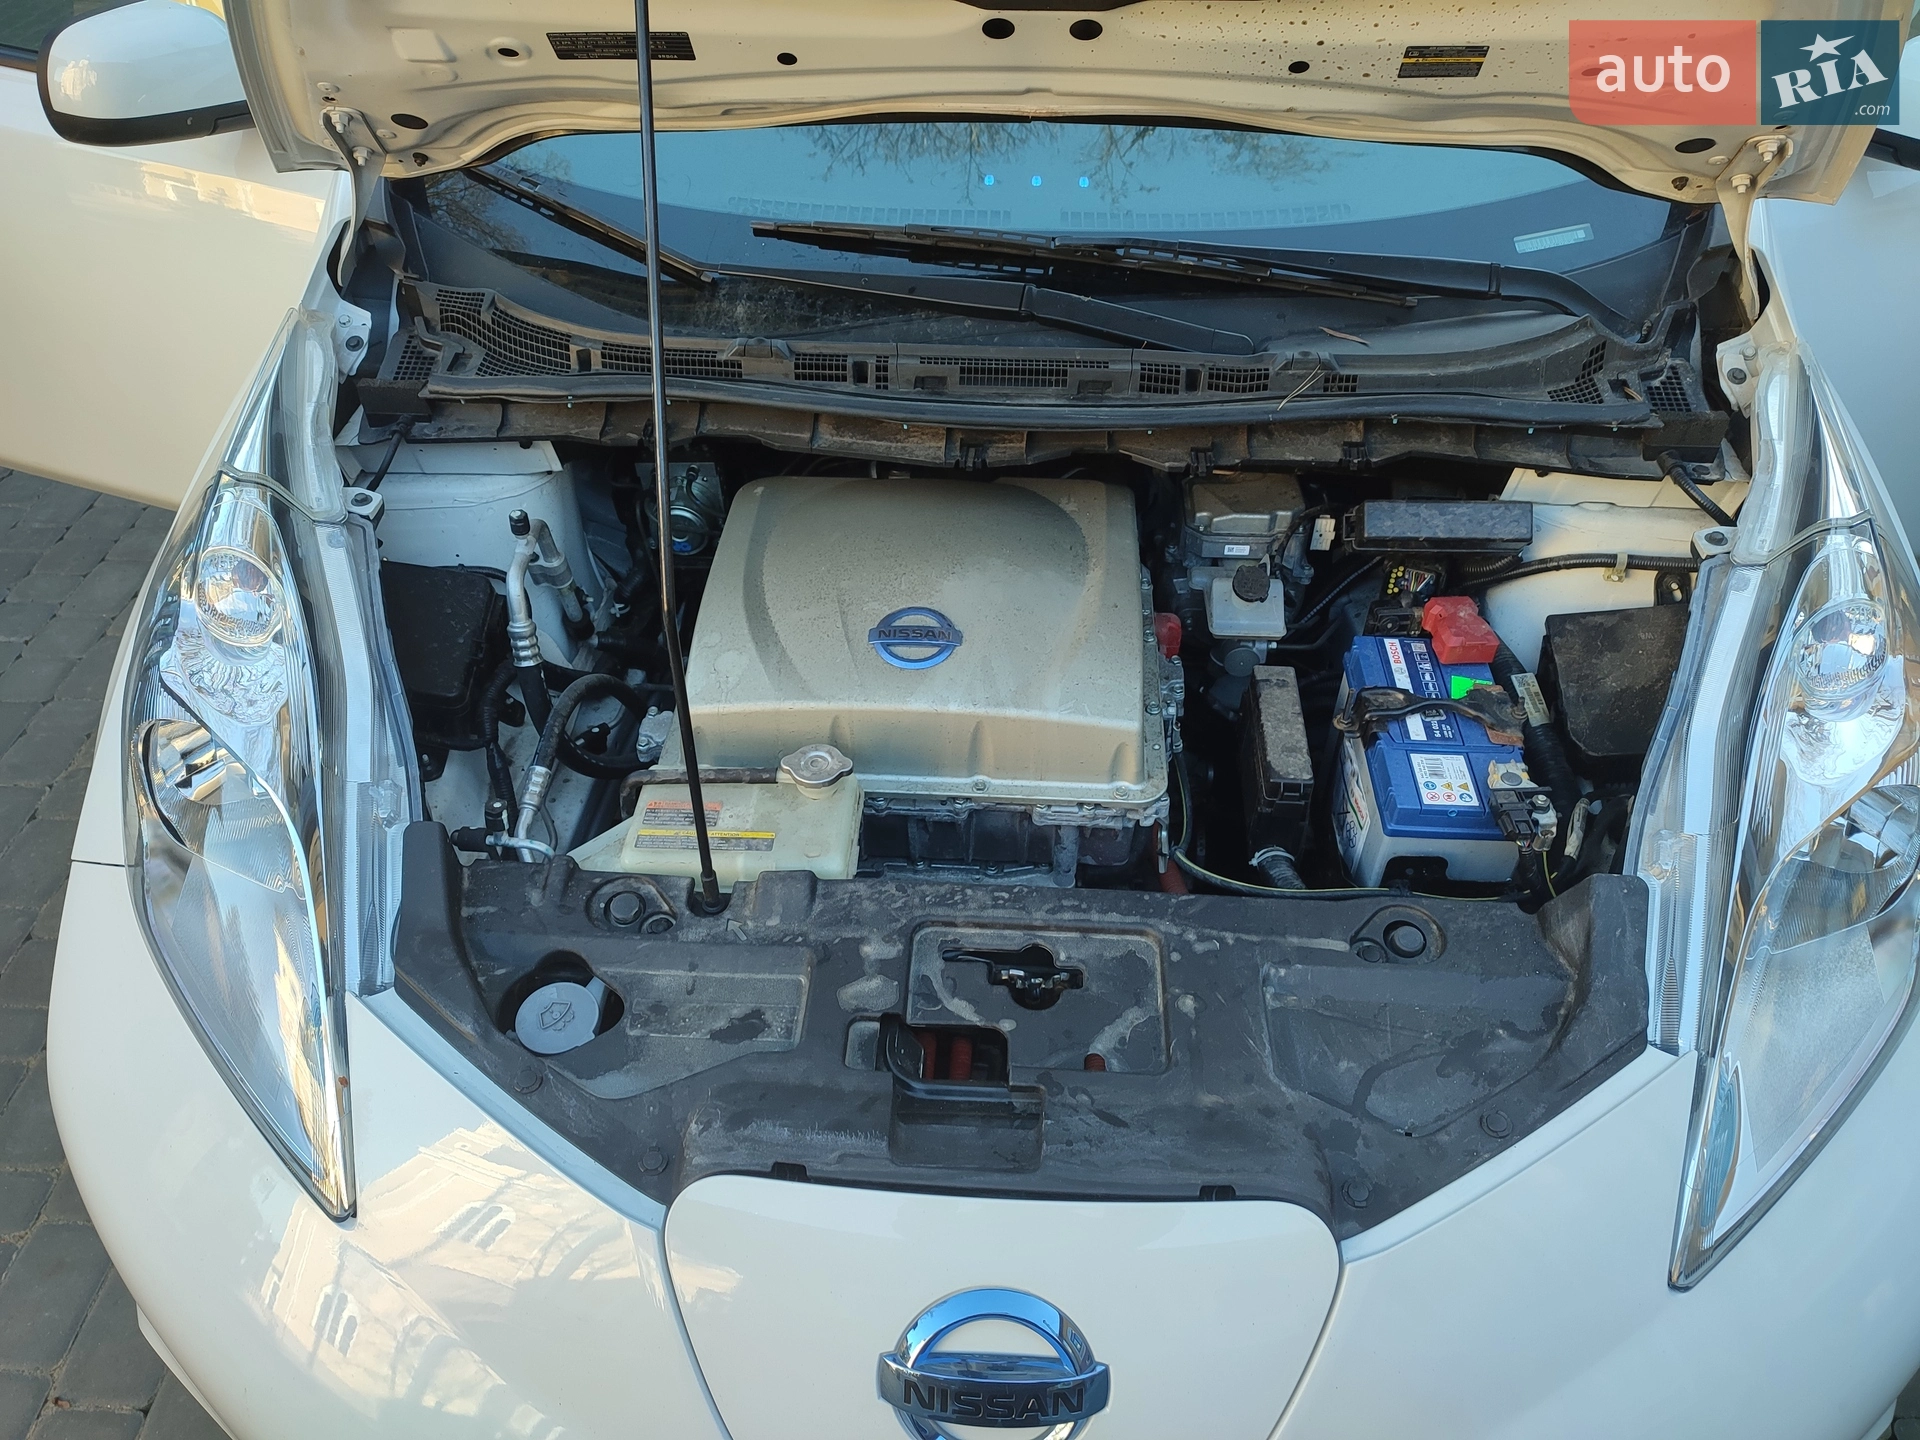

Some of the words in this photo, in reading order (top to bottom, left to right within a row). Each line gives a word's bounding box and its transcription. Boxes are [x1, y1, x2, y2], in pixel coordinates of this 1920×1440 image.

[878, 628, 951, 640] NISSAN
[1388, 641, 1403, 665] BOSCH
[903, 1378, 1084, 1420] NISSAN
